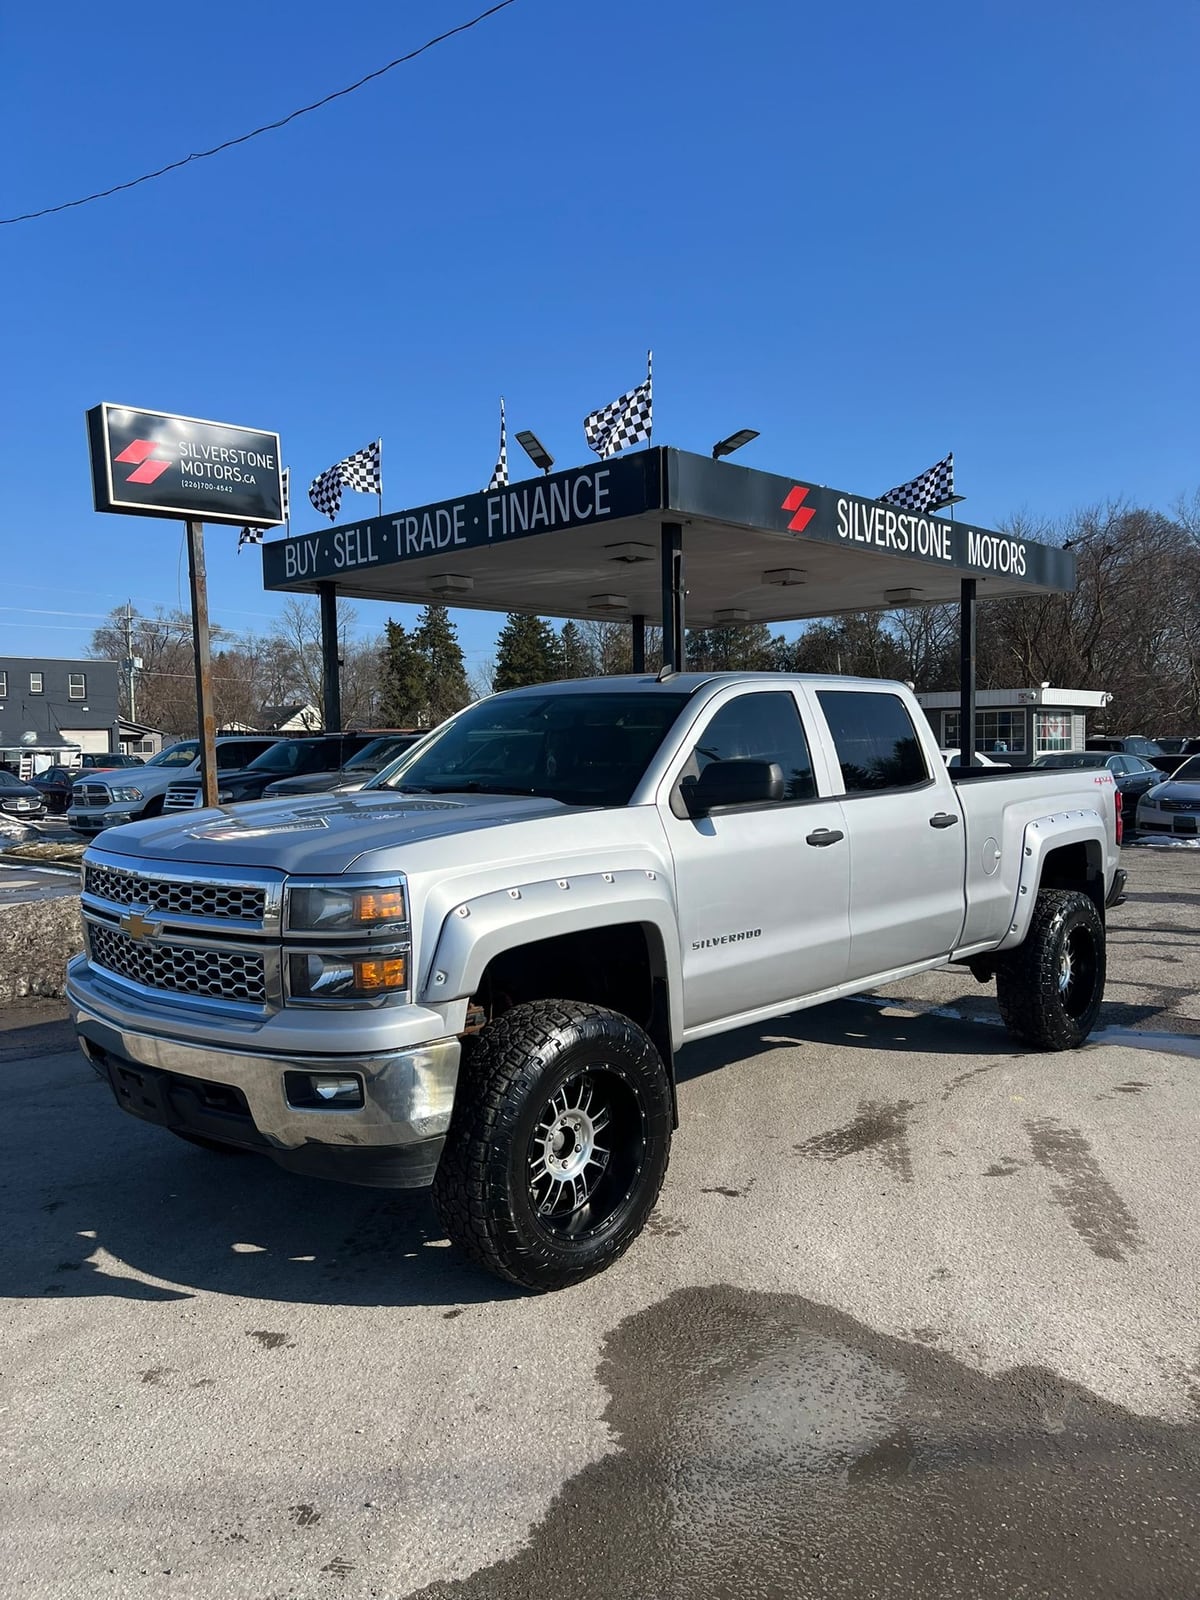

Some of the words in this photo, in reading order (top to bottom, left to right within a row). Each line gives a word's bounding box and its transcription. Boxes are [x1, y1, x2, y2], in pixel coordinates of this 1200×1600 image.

[179, 441, 275, 470] SILVERSTONE
[180, 459, 256, 485] MOTORS.CA
[285, 539, 320, 578] BUY
[333, 526, 379, 568] SELL
[392, 504, 467, 556] TRADE
[487, 469, 611, 538] FINANCE
[837, 498, 953, 561] SILVERSTONE
[967, 531, 1027, 577] MOTORS
[692, 928, 762, 950] SILVERADO
